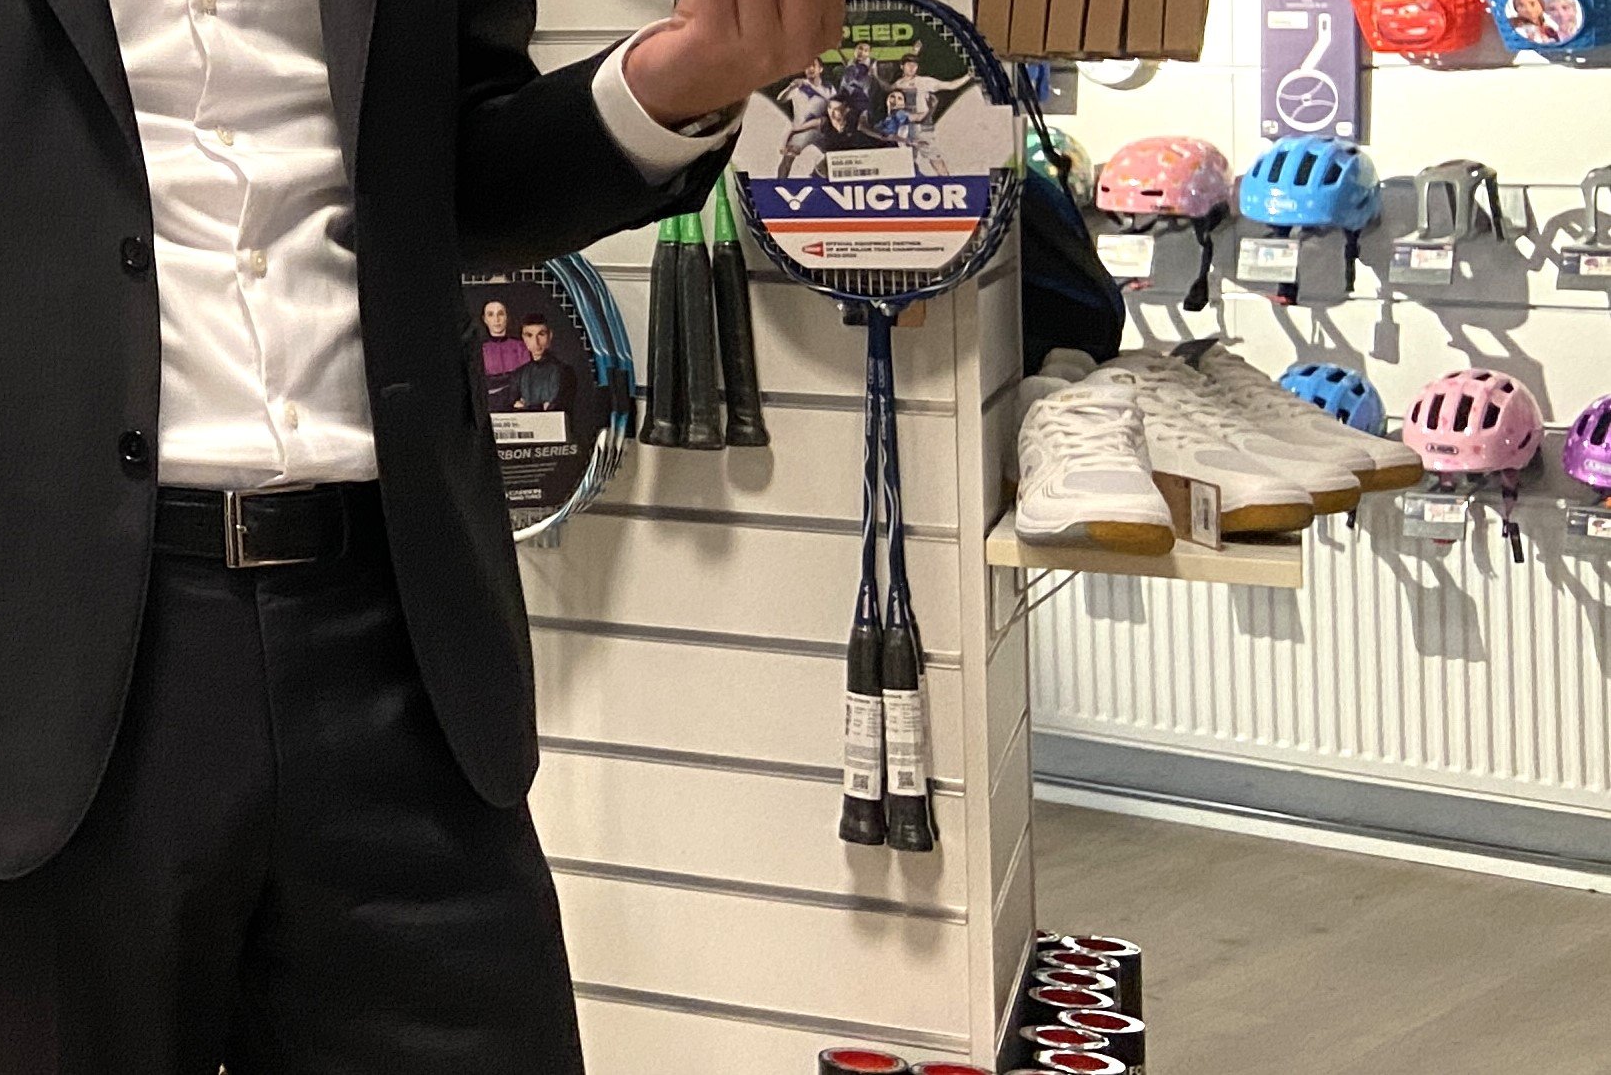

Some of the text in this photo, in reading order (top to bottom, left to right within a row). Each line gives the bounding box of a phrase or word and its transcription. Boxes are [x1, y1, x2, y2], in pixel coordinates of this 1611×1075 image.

[842, 22, 914, 43] EED
[822, 183, 968, 211] VICTOR
[497, 444, 578, 461] RBON SERIES
